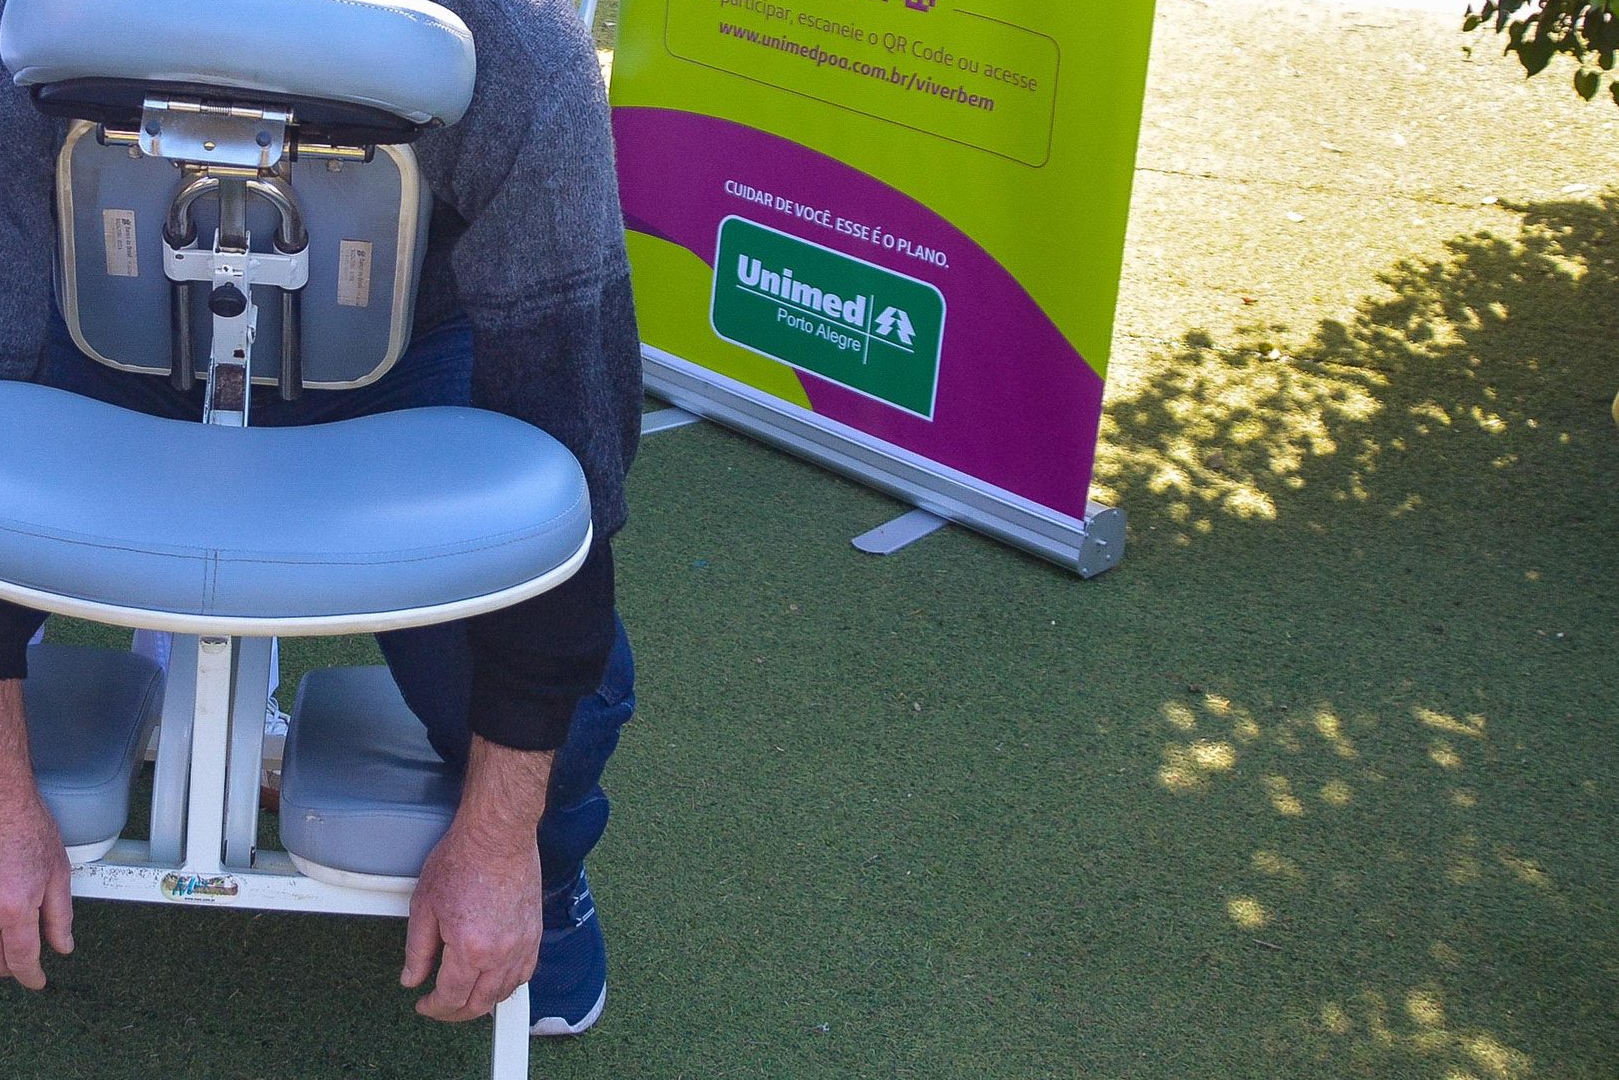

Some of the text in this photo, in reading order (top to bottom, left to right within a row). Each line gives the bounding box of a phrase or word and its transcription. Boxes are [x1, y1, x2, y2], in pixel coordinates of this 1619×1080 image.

[717, 21, 995, 112] www.unimedpoa.com.br/viverbem
[797, 11, 865, 43] escaneie
[868, 30, 878, 45] o
[882, 31, 907, 53] QR
[911, 40, 954, 67] Code
[958, 54, 979, 73] ou
[983, 62, 1039, 92] acesse
[724, 179, 950, 269] CUIDAR DE VOCÊ. ESSE É O PLANO.
[736, 253, 867, 328] Unimed
[776, 307, 862, 353] Porto Alegre
